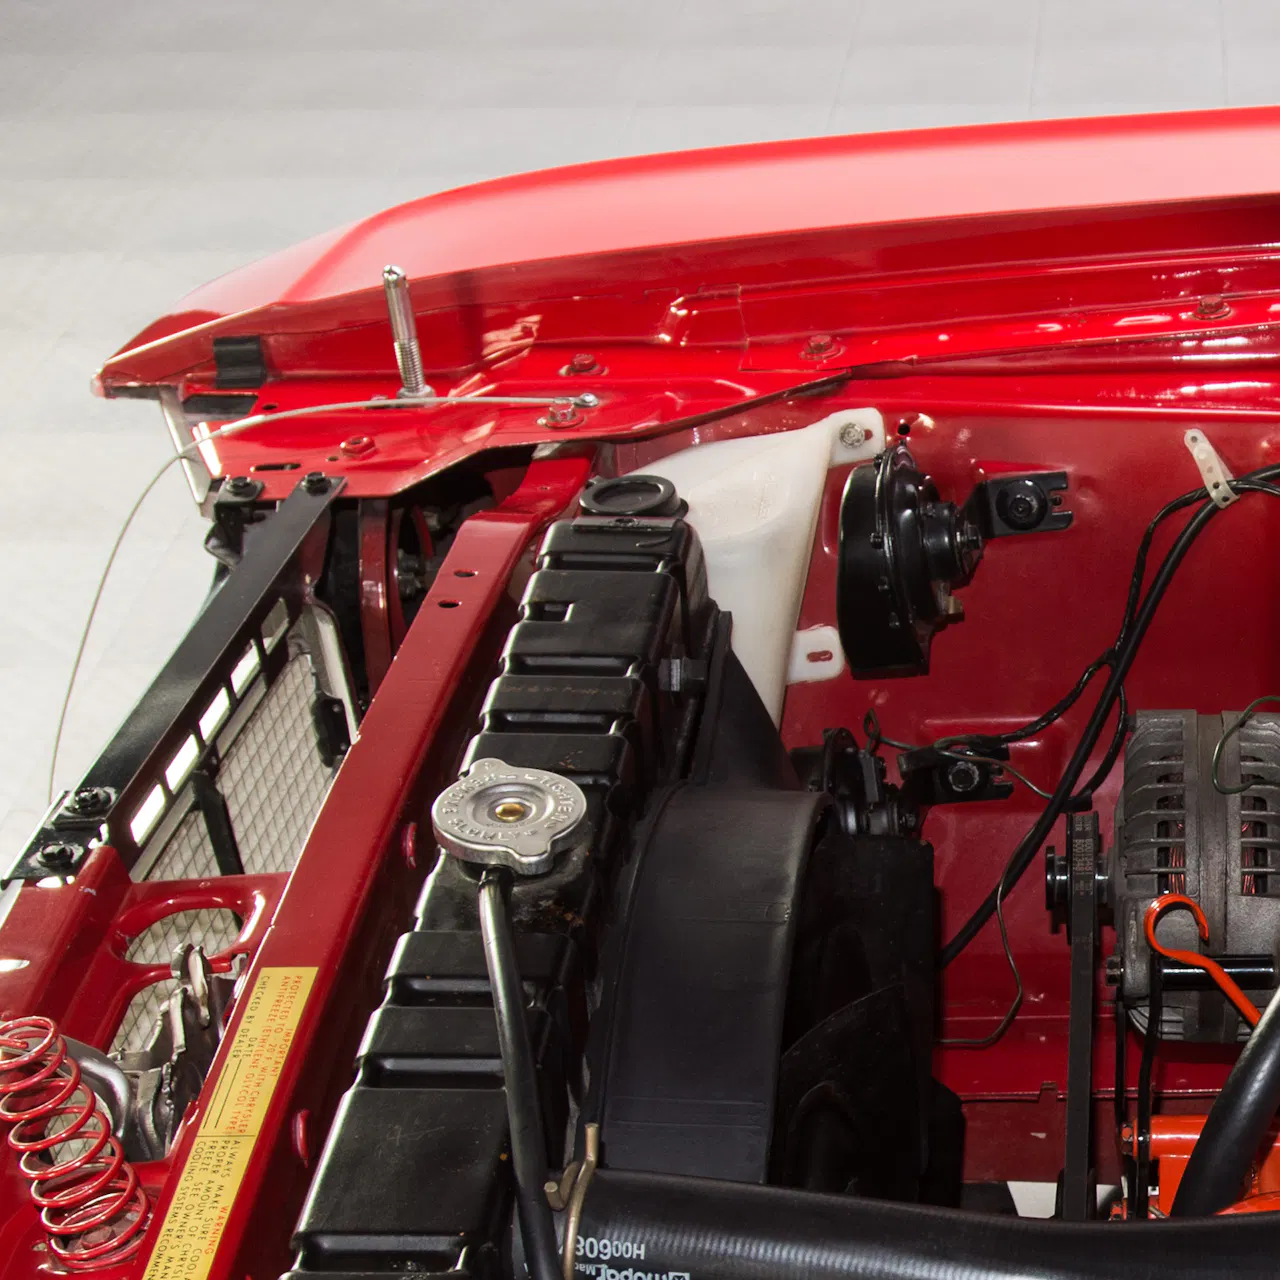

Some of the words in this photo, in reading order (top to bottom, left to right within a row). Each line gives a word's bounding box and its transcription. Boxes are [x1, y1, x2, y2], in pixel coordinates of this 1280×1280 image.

[250, 975, 270, 1011] CHECKED
[266, 975, 290, 1023] ANTIFREEZE
[279, 975, 302, 1020] PROTECTED
[246, 1015, 255, 1023] BY
[274, 1023, 286, 1033] TO
[232, 1028, 250, 1058] DEALER
[242, 1037, 257, 1057] DATE
[270, 1028, 293, 1077] IMPORTANT
[235, 1073, 255, 1106] GLYCOL
[255, 1066, 268, 1087] WITH
[237, 1090, 260, 1133] CHRYSLER
[184, 1141, 206, 1181] COOLING
[199, 1140, 218, 1172] FREEZE
[212, 1140, 231, 1174] PROPER
[221, 1140, 241, 1178] ALWAYS
[168, 1187, 189, 1224] SYSTEMS
[189, 1182, 203, 1197] SEE
[193, 1180, 215, 1220] AMOUNT
[208, 1185, 224, 1210] MAKE
[170, 1204, 195, 1250] OWNER'S
[188, 1226, 198, 1237] OF
[197, 1218, 214, 1240] SURE
[204, 1205, 229, 1254] WARNING
